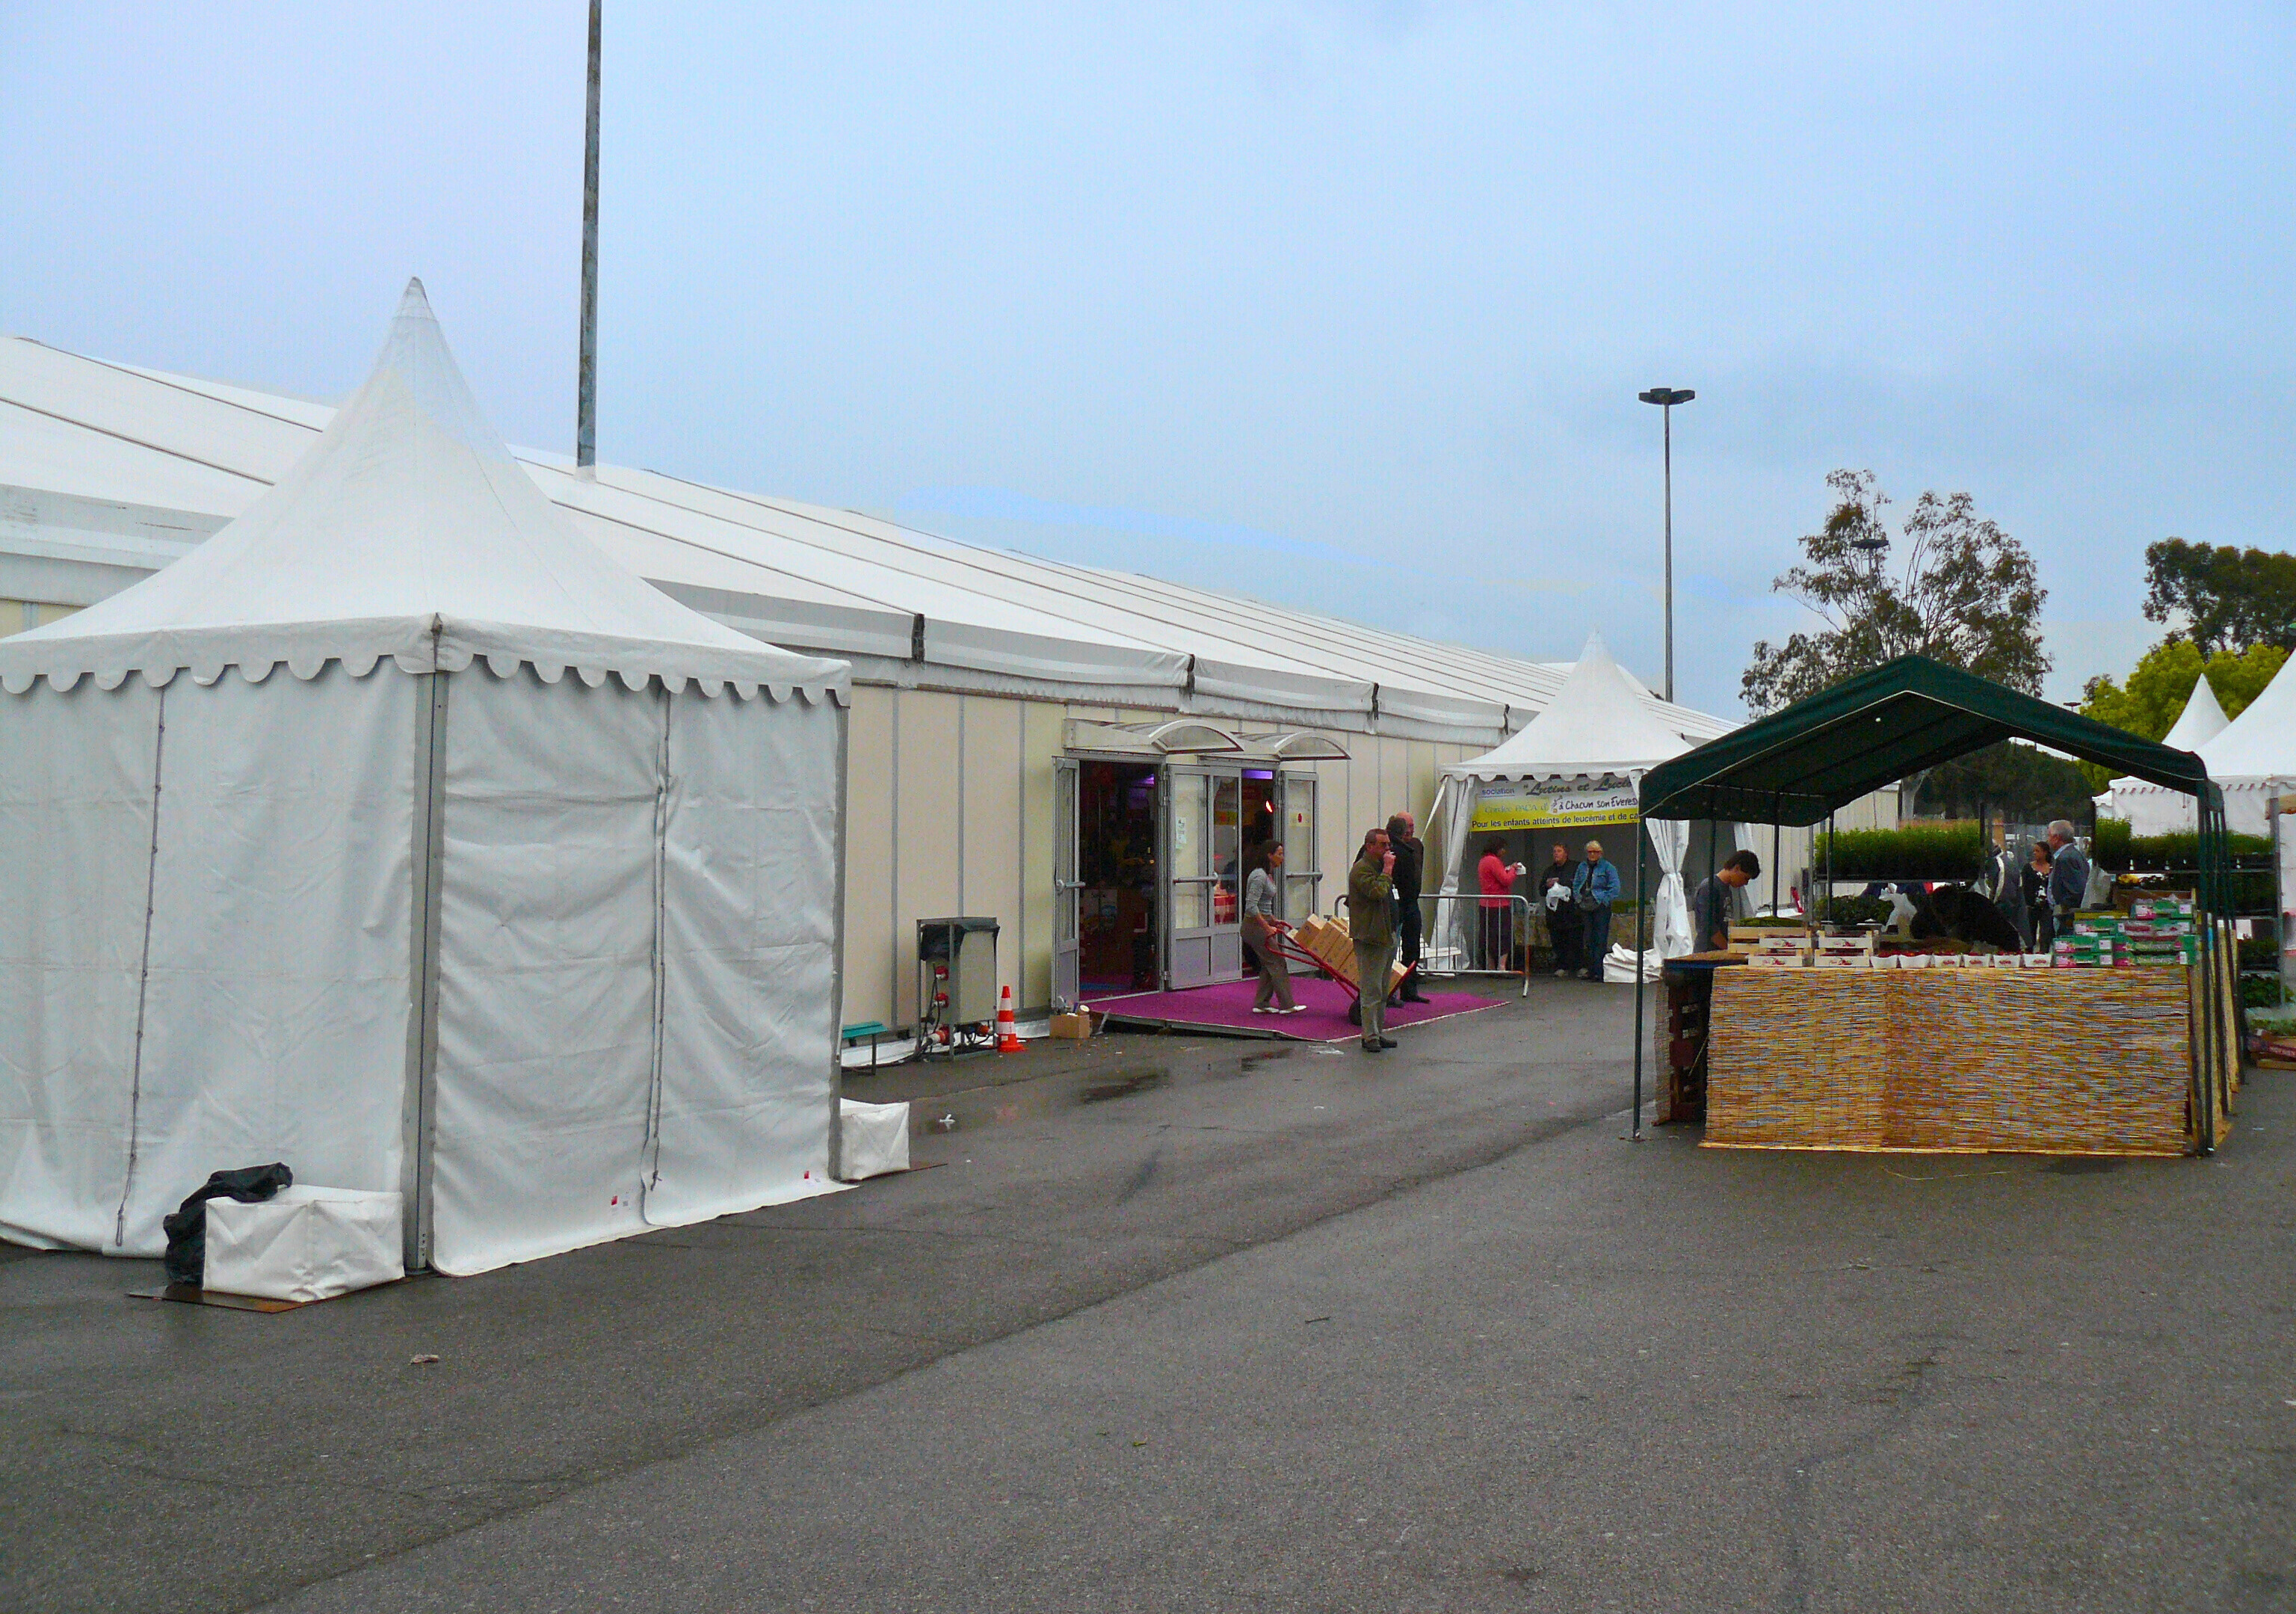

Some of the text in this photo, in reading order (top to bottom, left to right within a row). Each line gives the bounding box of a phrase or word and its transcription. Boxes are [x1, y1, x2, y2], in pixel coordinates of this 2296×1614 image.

[1565, 800, 1593, 810] Chacun
[1596, 800, 1610, 808] son
[1610, 795, 1638, 807] Everes
[1472, 820, 1488, 828] Pour
[1503, 818, 1531, 826] enfants
[1532, 816, 1561, 825] atteints
[1617, 812, 1627, 820] de
